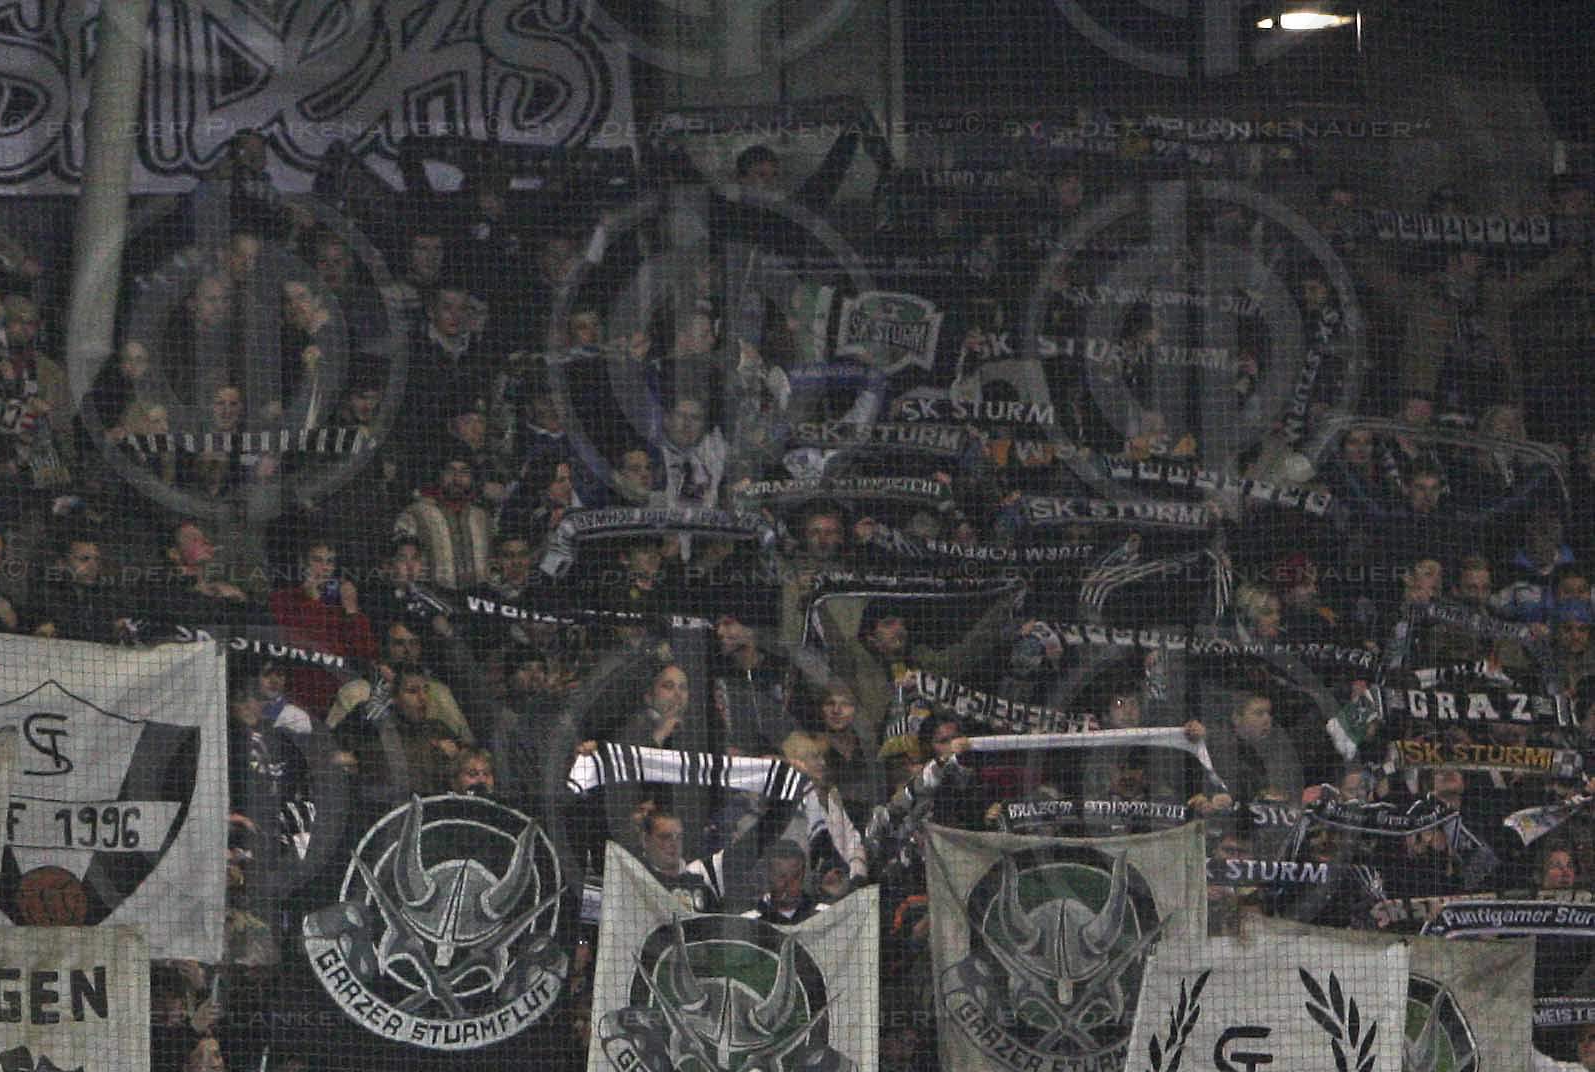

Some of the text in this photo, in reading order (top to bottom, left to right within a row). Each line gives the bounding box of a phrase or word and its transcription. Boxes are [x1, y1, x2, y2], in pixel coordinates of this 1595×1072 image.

[898, 397, 1052, 427] SK STURM
[796, 423, 957, 451] SK STURM
[1030, 498, 1207, 527] SK STURM
[1407, 689, 1533, 722] GRAZ
[1403, 740, 1555, 770] SK STURM
[54, 805, 142, 849] 1996
[1223, 858, 1329, 886] STURM
[1440, 904, 1550, 929] Puntigamer
[315, 948, 555, 1046] GRAZER STURMFLUT
